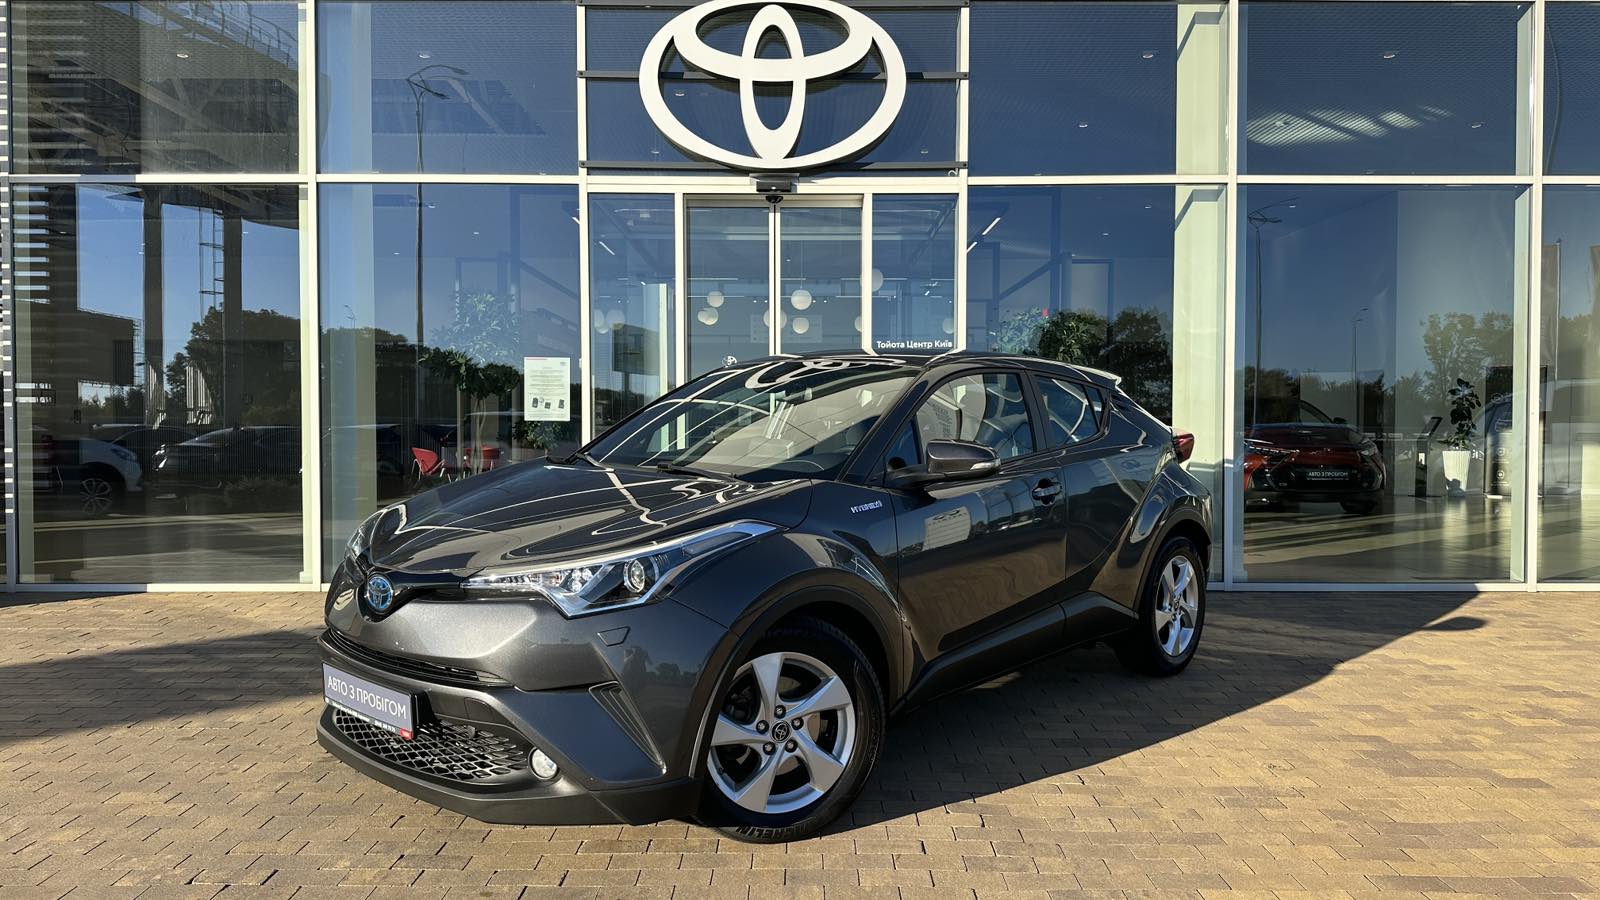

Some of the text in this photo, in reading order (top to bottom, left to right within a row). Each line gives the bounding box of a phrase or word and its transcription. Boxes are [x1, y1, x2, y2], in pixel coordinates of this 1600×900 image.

[876, 340, 953, 349] Тойота Центр Київ
[328, 675, 348, 696] АВТО
[349, 685, 355, 699] З
[356, 688, 407, 719] ПРОБІГОМ
